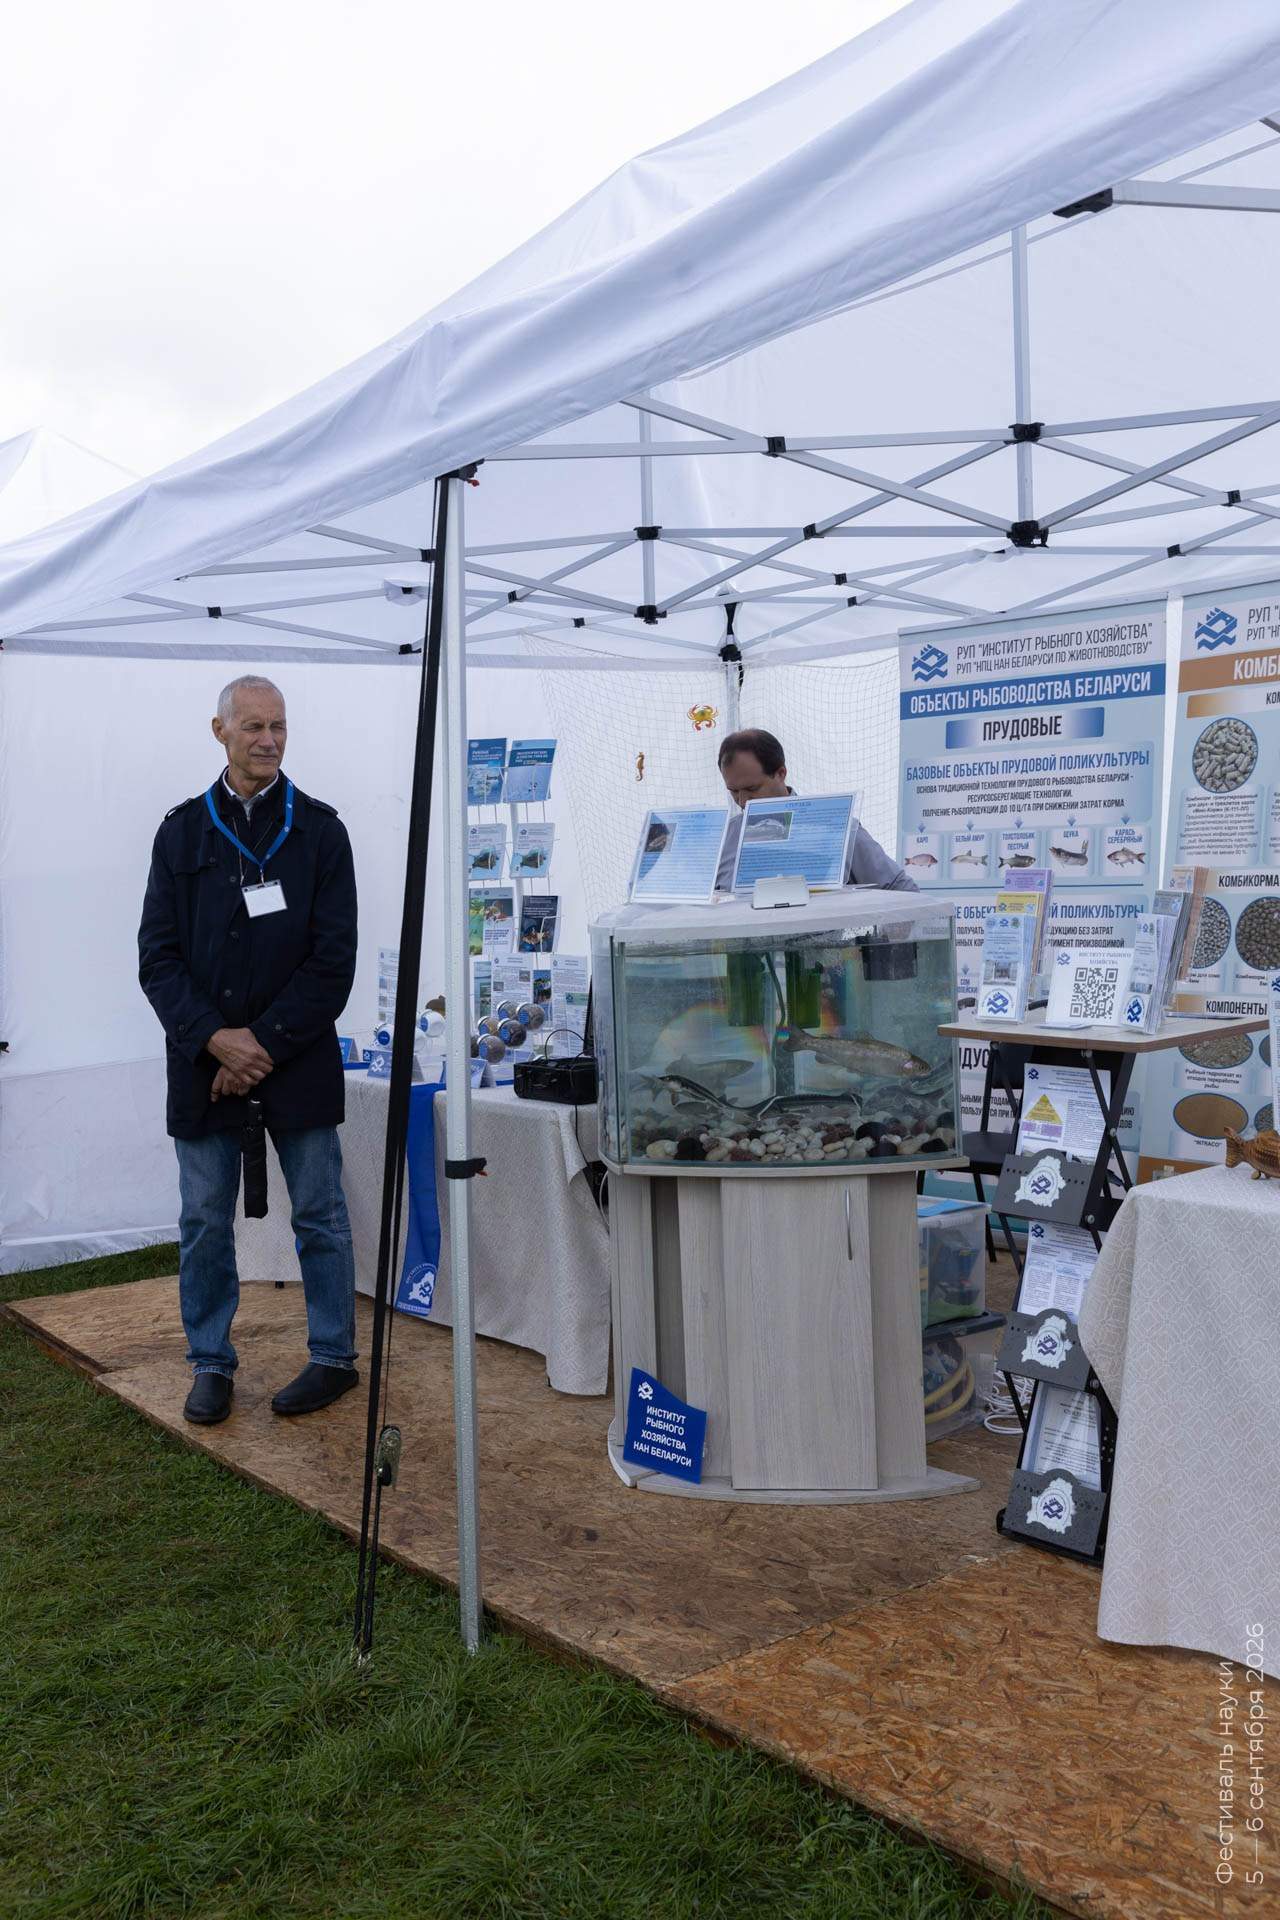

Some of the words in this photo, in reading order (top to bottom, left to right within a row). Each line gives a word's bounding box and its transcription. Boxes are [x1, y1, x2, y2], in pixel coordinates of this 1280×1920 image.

[1248, 606, 1270, 624] РУП
[957, 644, 976, 660] РУП
[978, 638, 1032, 656] "ИНСТИТУТ
[1036, 632, 1082, 650] РЫБНОГО
[1086, 622, 1152, 645] ХОЗЯЙСТВА"
[1247, 626, 1265, 640] РУП
[956, 662, 972, 675] РУП
[974, 660, 992, 674] "НПЦ
[994, 658, 1009, 671] НАН
[1012, 654, 1053, 668] БЕЛАРУСИ
[1056, 652, 1066, 664] ПО
[1068, 641, 1152, 662] ЖИВОТНОВОДСТВУ"
[911, 690, 969, 714] ОБЪЕКТЫ
[972, 680, 1070, 708] РЫБОВОДСТВА
[1075, 672, 1151, 698] БЕЛАРУСИ
[983, 716, 1062, 741] ПРУДОВЫЕ
[906, 764, 951, 780] БАЗОВЫЕ
[954, 760, 999, 777] ОБЪЕКТЫ
[1002, 754, 1057, 774] ПРУДОВОЙ
[1060, 750, 1150, 771] ПОЛИКУЛЬТУРЫ
[916, 785, 937, 794] ОСНОВА
[938, 781, 980, 792] ТРАДИЦИОННОЙ
[981, 780, 1016, 790] ТЕХНОЛОГИИ
[1017, 778, 1051, 788] ПРУДОВОГО
[1052, 774, 1096, 786] РЫБОВОДСТВА
[1097, 773, 1129, 783] БЕЛАРУСИ
[968, 791, 1031, 803] РЕСУРСОСБЕРЕГАЮЩИЕ
[922, 808, 951, 817] ПОЛЧЕНИЕ
[951, 806, 998, 816] РЫБОПРОДУКЦИИ
[1000, 804, 1007, 814] ДО
[1009, 804, 1016, 813] 10
[1017, 803, 1031, 812] Ц/ГА
[1032, 802, 1044, 811] ПРИ
[1045, 801, 1078, 811] СНИЖЕНИИ
[1080, 800, 1102, 809] ЗАТРАТ
[1103, 799, 1124, 808] КОРМА
[1219, 874, 1280, 887] КОМБИКОРМА
[1060, 904, 1144, 918] ПОЛИКУЛЬТУРЫ
[957, 926, 984, 934] ПОЛУЧАТЬ
[1079, 926, 1090, 934] БЕЗ
[1091, 926, 1114, 934] ЗАТРАТ
[1075, 938, 1124, 948] ПРОИЗВОДИМОЙ
[1206, 1000, 1267, 1015] КОМПОНЕНТЫ
[646, 1405, 686, 1424] ИНСТИТУТ
[646, 1417, 684, 1436] РЫБНОГО
[641, 1429, 687, 1452] ХОЗЯЙСТВА
[633, 1441, 650, 1454] НАН
[651, 1447, 692, 1467] БЕЛАРУСИ
